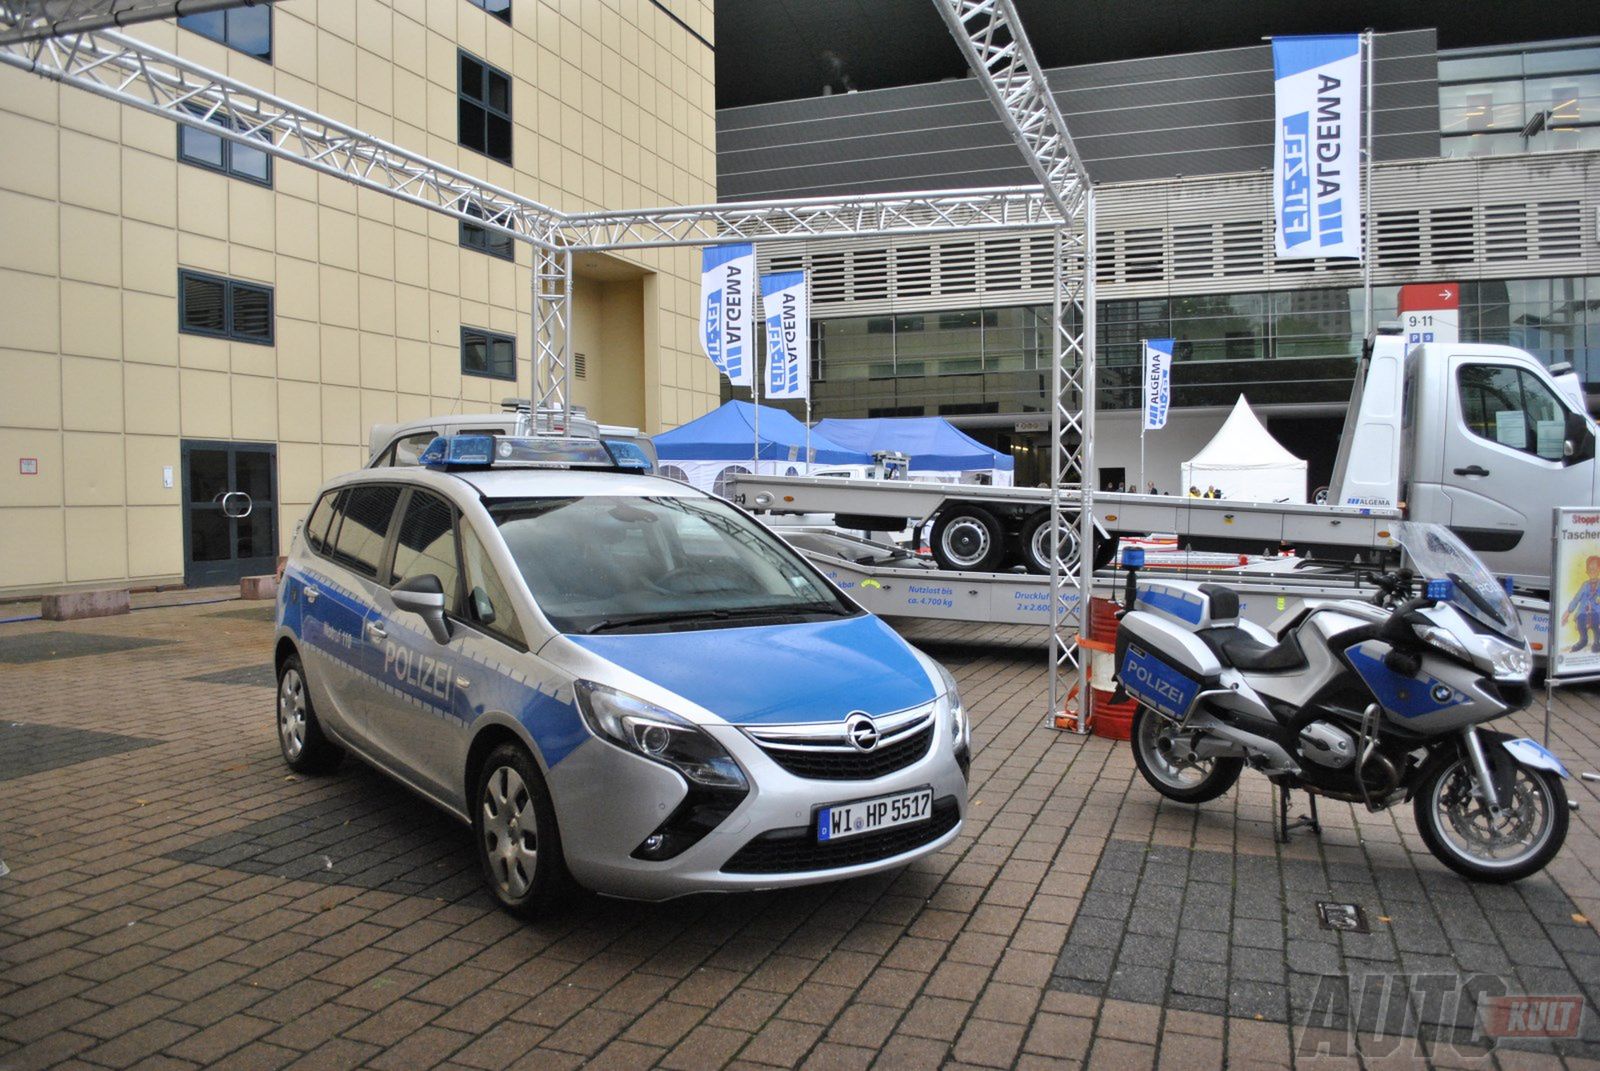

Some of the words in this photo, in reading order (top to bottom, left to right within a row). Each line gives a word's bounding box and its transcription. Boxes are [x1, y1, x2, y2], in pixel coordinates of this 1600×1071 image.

[1151, 354, 1161, 404] ALGEMA
[941, 587, 953, 595] bis
[943, 598, 953, 608] kg
[384, 641, 453, 700] POLIZEI
[1128, 660, 1184, 704] POLIZEI
[831, 808, 852, 835] WI
[866, 802, 887, 828] HP
[892, 793, 930, 822] 5517
